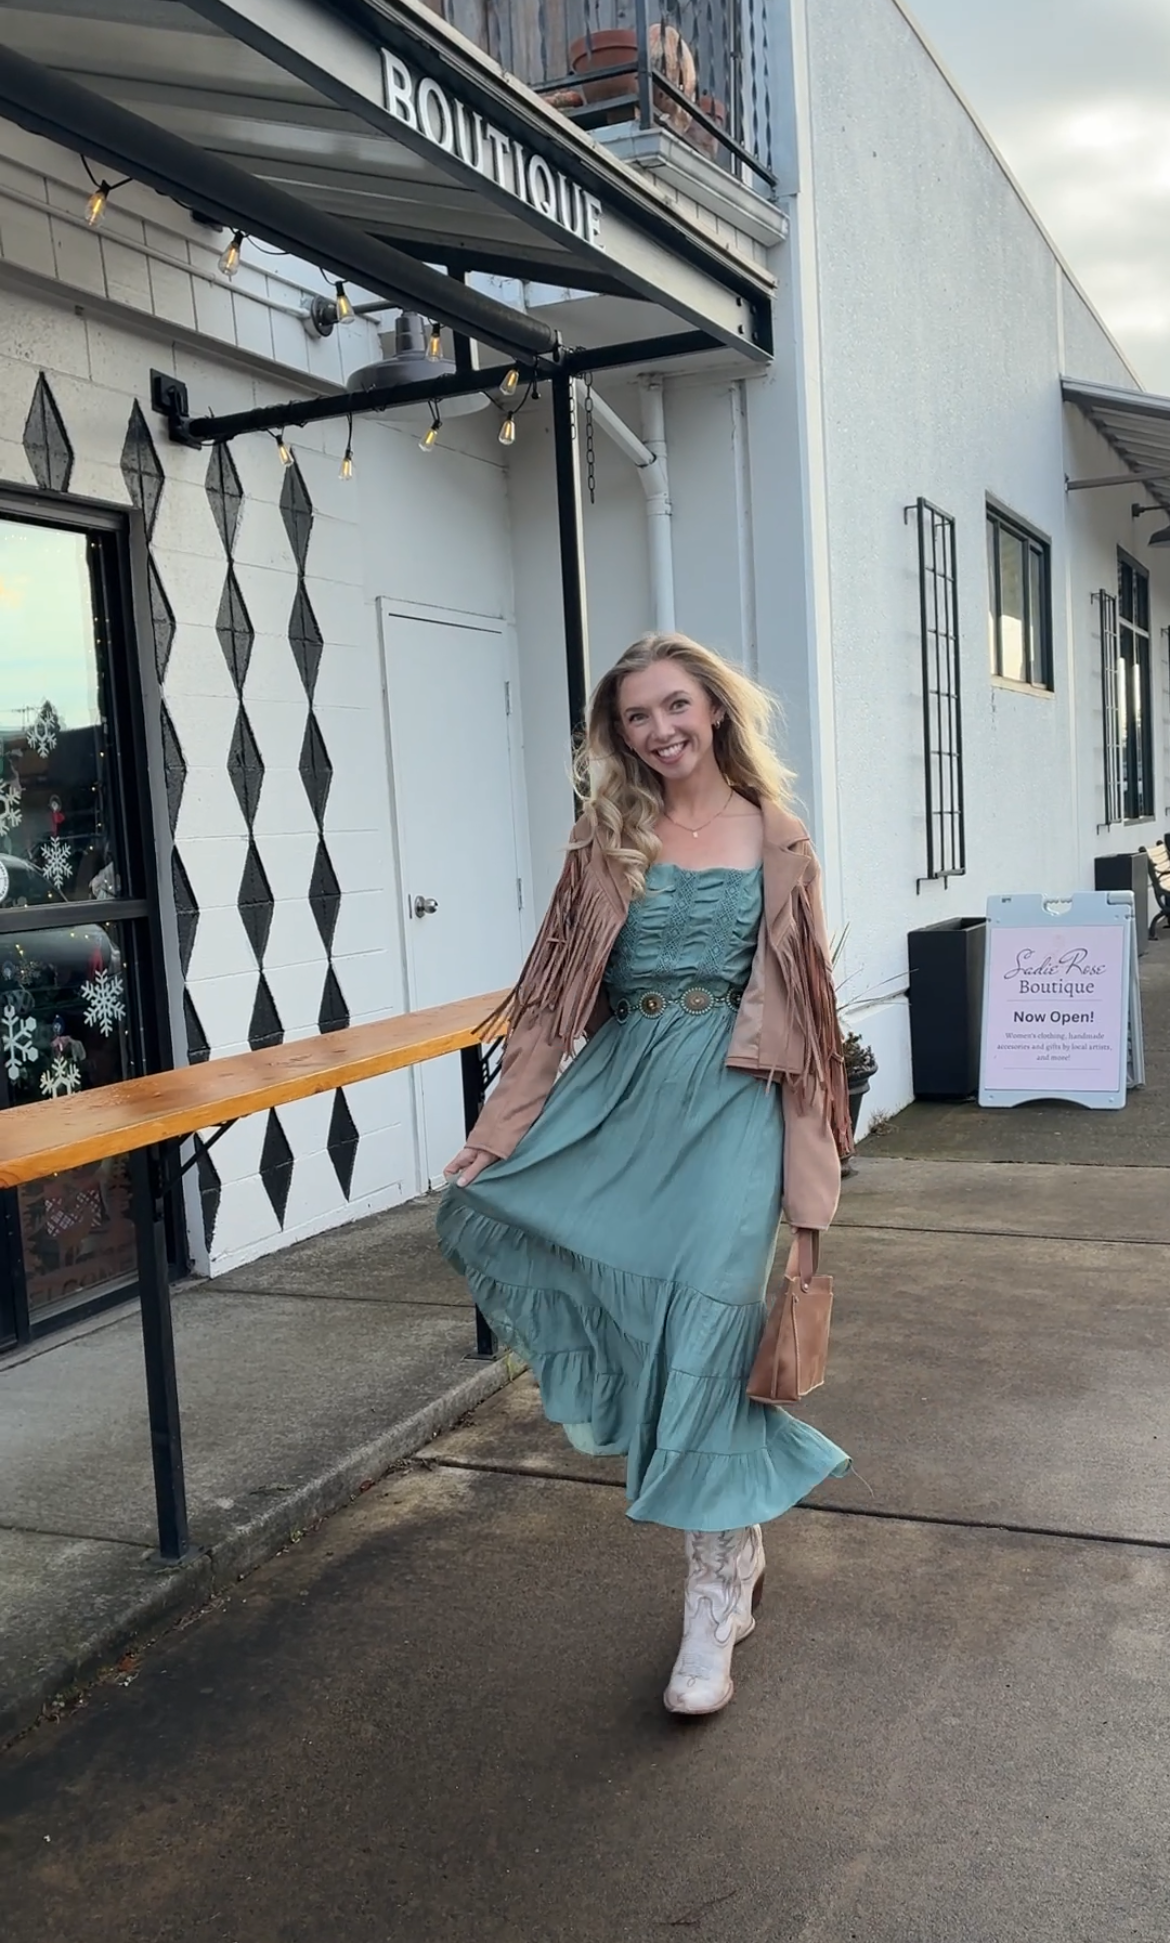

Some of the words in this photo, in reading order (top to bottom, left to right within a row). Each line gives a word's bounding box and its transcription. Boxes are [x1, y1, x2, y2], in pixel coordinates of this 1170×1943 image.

[380, 47, 606, 250] BOUTIQUE
[1003, 948, 1059, 980] Sadie
[1058, 947, 1107, 976] Rose
[1019, 978, 1095, 998] Boutique
[1013, 1011, 1046, 1023] Now
[1050, 1010, 1095, 1026] Open!
[1005, 1032, 1036, 1040] Women's
[1037, 1032, 1068, 1041] clothing,
[1068, 1032, 1105, 1040] handmade
[1031, 1043, 1045, 1051] and
[1045, 1043, 1061, 1052] gifts
[1062, 1043, 1070, 1052] by
[1071, 1043, 1088, 1051] local
[1088, 1043, 1113, 1052] artists,
[1050, 1054, 1071, 1062] more!
